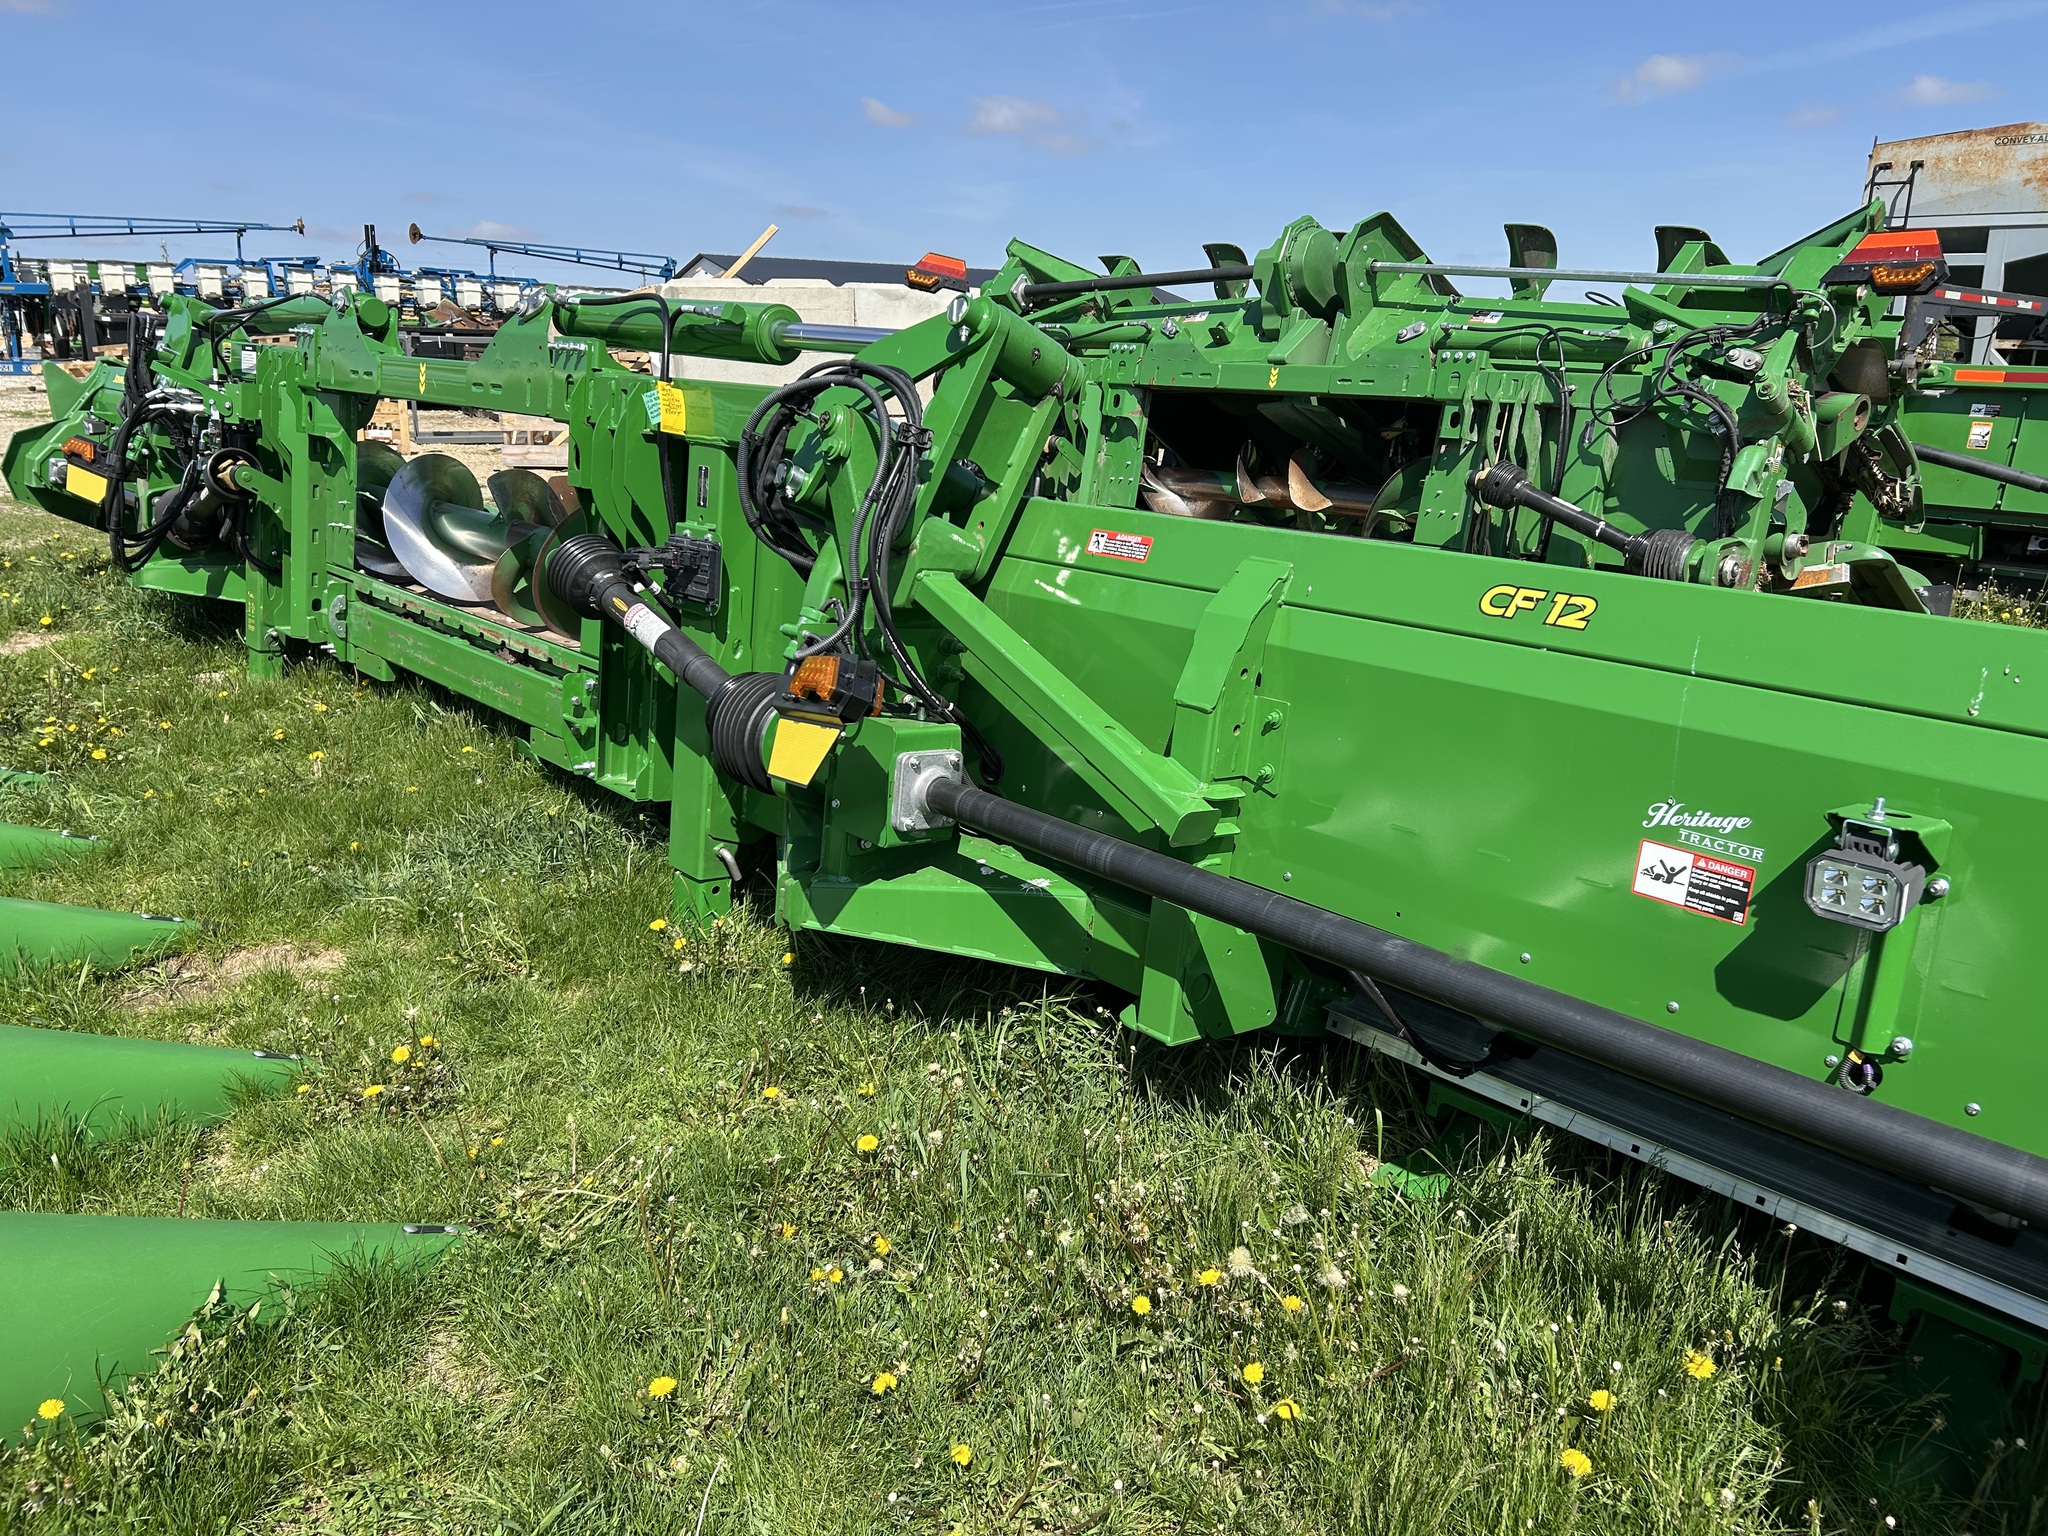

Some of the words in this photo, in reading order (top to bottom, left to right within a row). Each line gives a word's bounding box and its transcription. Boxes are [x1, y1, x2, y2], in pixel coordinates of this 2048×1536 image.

[1479, 584, 1550, 619] CF
[1543, 592, 1598, 631] 12
[1642, 802, 1752, 834] Heritage
[1679, 830, 1764, 861] TRACTOR
[1707, 861, 1747, 878] DANGER
